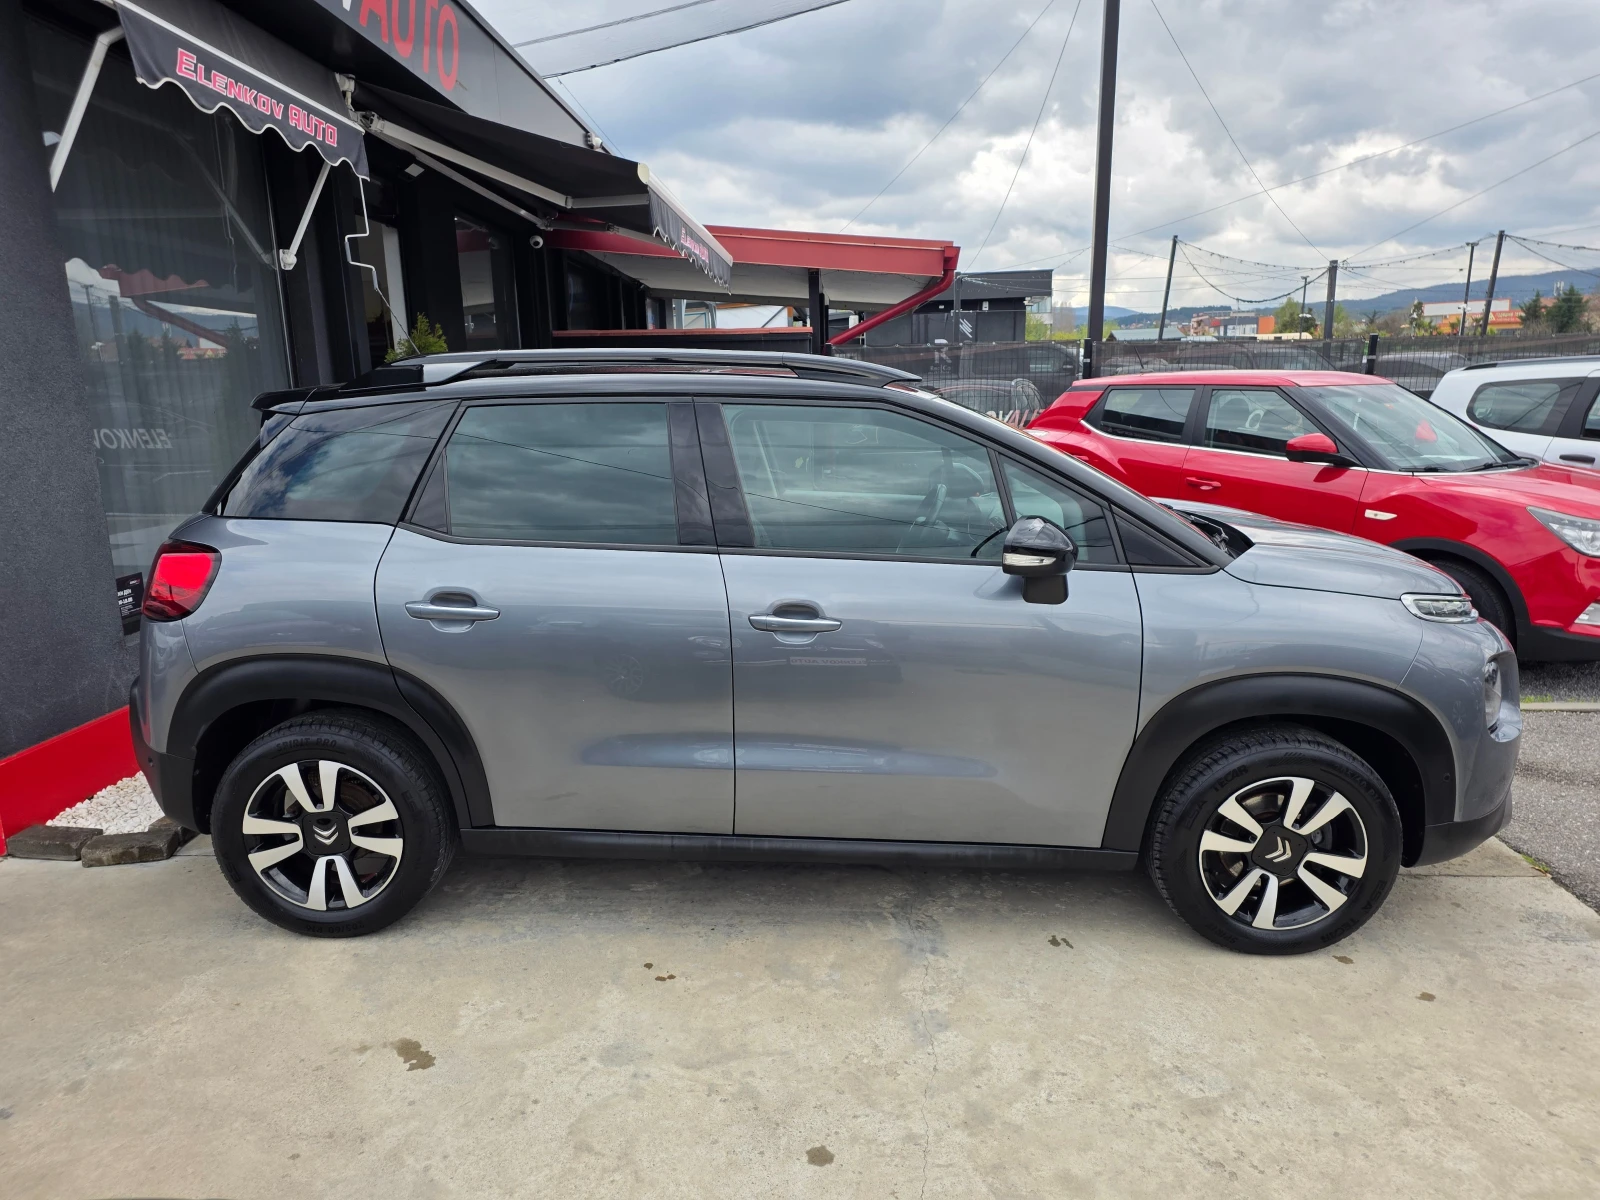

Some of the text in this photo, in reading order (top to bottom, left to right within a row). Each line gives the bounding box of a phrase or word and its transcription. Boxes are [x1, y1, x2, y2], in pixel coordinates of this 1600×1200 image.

[176, 47, 338, 147] ELENKOV AUTO
[315, 737, 338, 749] PRO
[1211, 764, 1249, 793] TECAR
